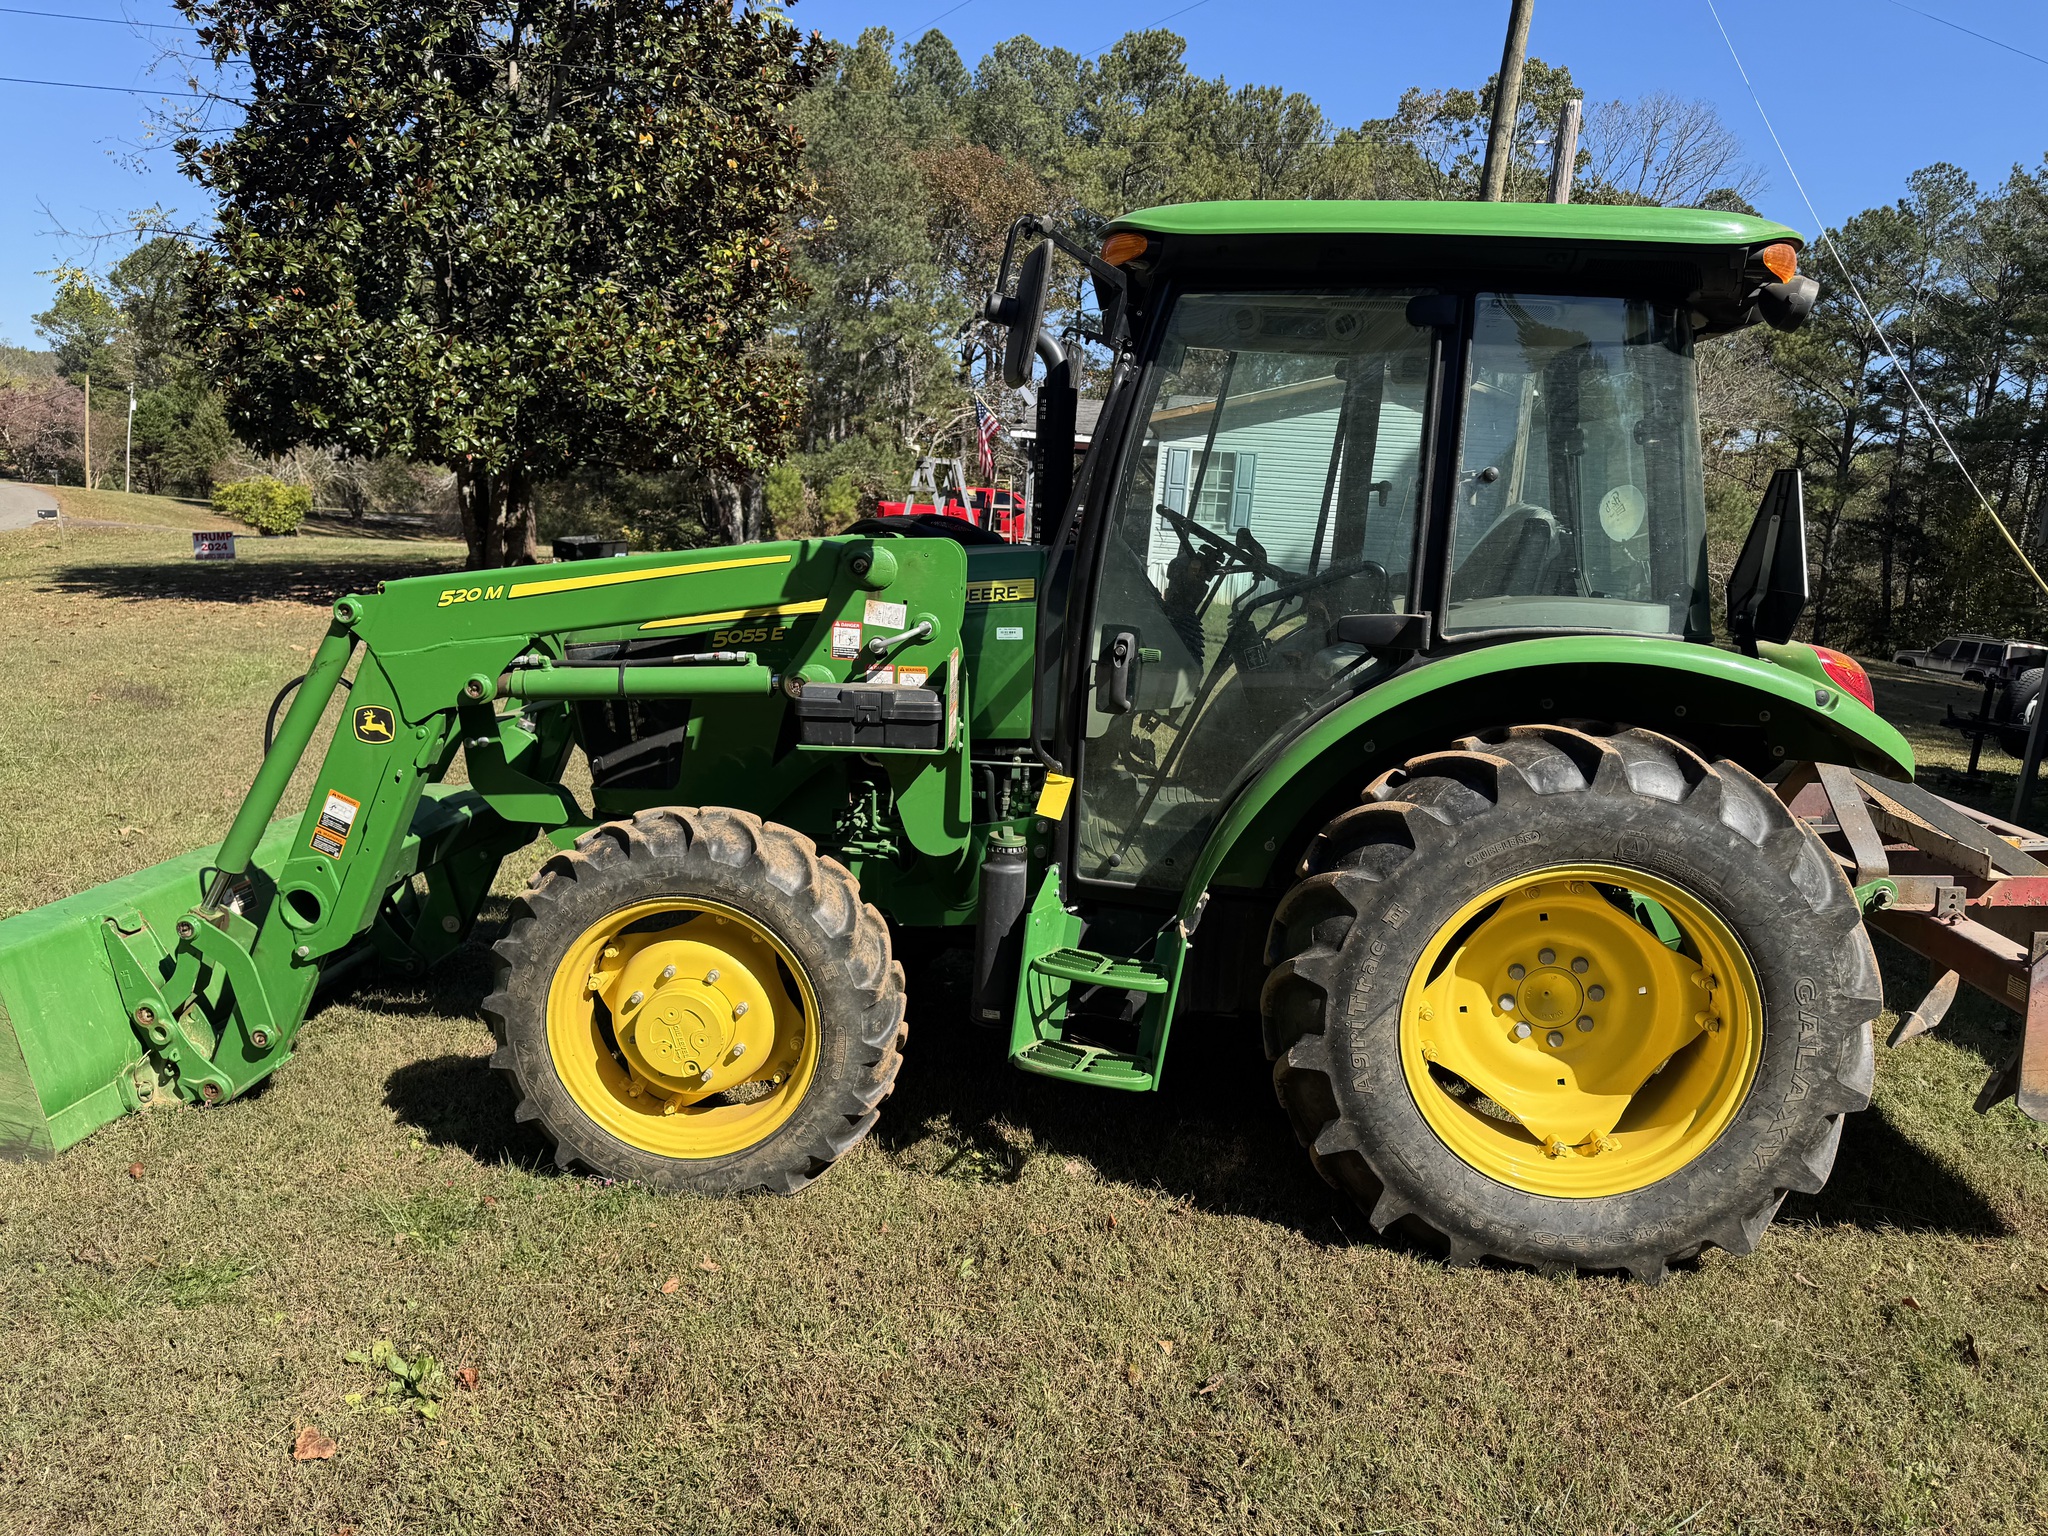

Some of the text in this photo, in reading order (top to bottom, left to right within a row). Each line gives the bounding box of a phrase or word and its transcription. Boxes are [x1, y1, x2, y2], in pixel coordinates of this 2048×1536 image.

[193, 532, 233, 542] TRUMP
[201, 542, 228, 551] 2024
[437, 585, 505, 607] 520 M
[711, 626, 787, 648] 5055 E
[337, 795, 357, 806] WARNING
[1473, 833, 1537, 864] TUBELESS
[717, 874, 823, 957] AgriTrac
[1346, 937, 1386, 1096] AgriTrac
[678, 1037, 689, 1058] LEVEL
[1749, 976, 1820, 1172] GALAXY
[519, 1049, 638, 1177] GALAXY
